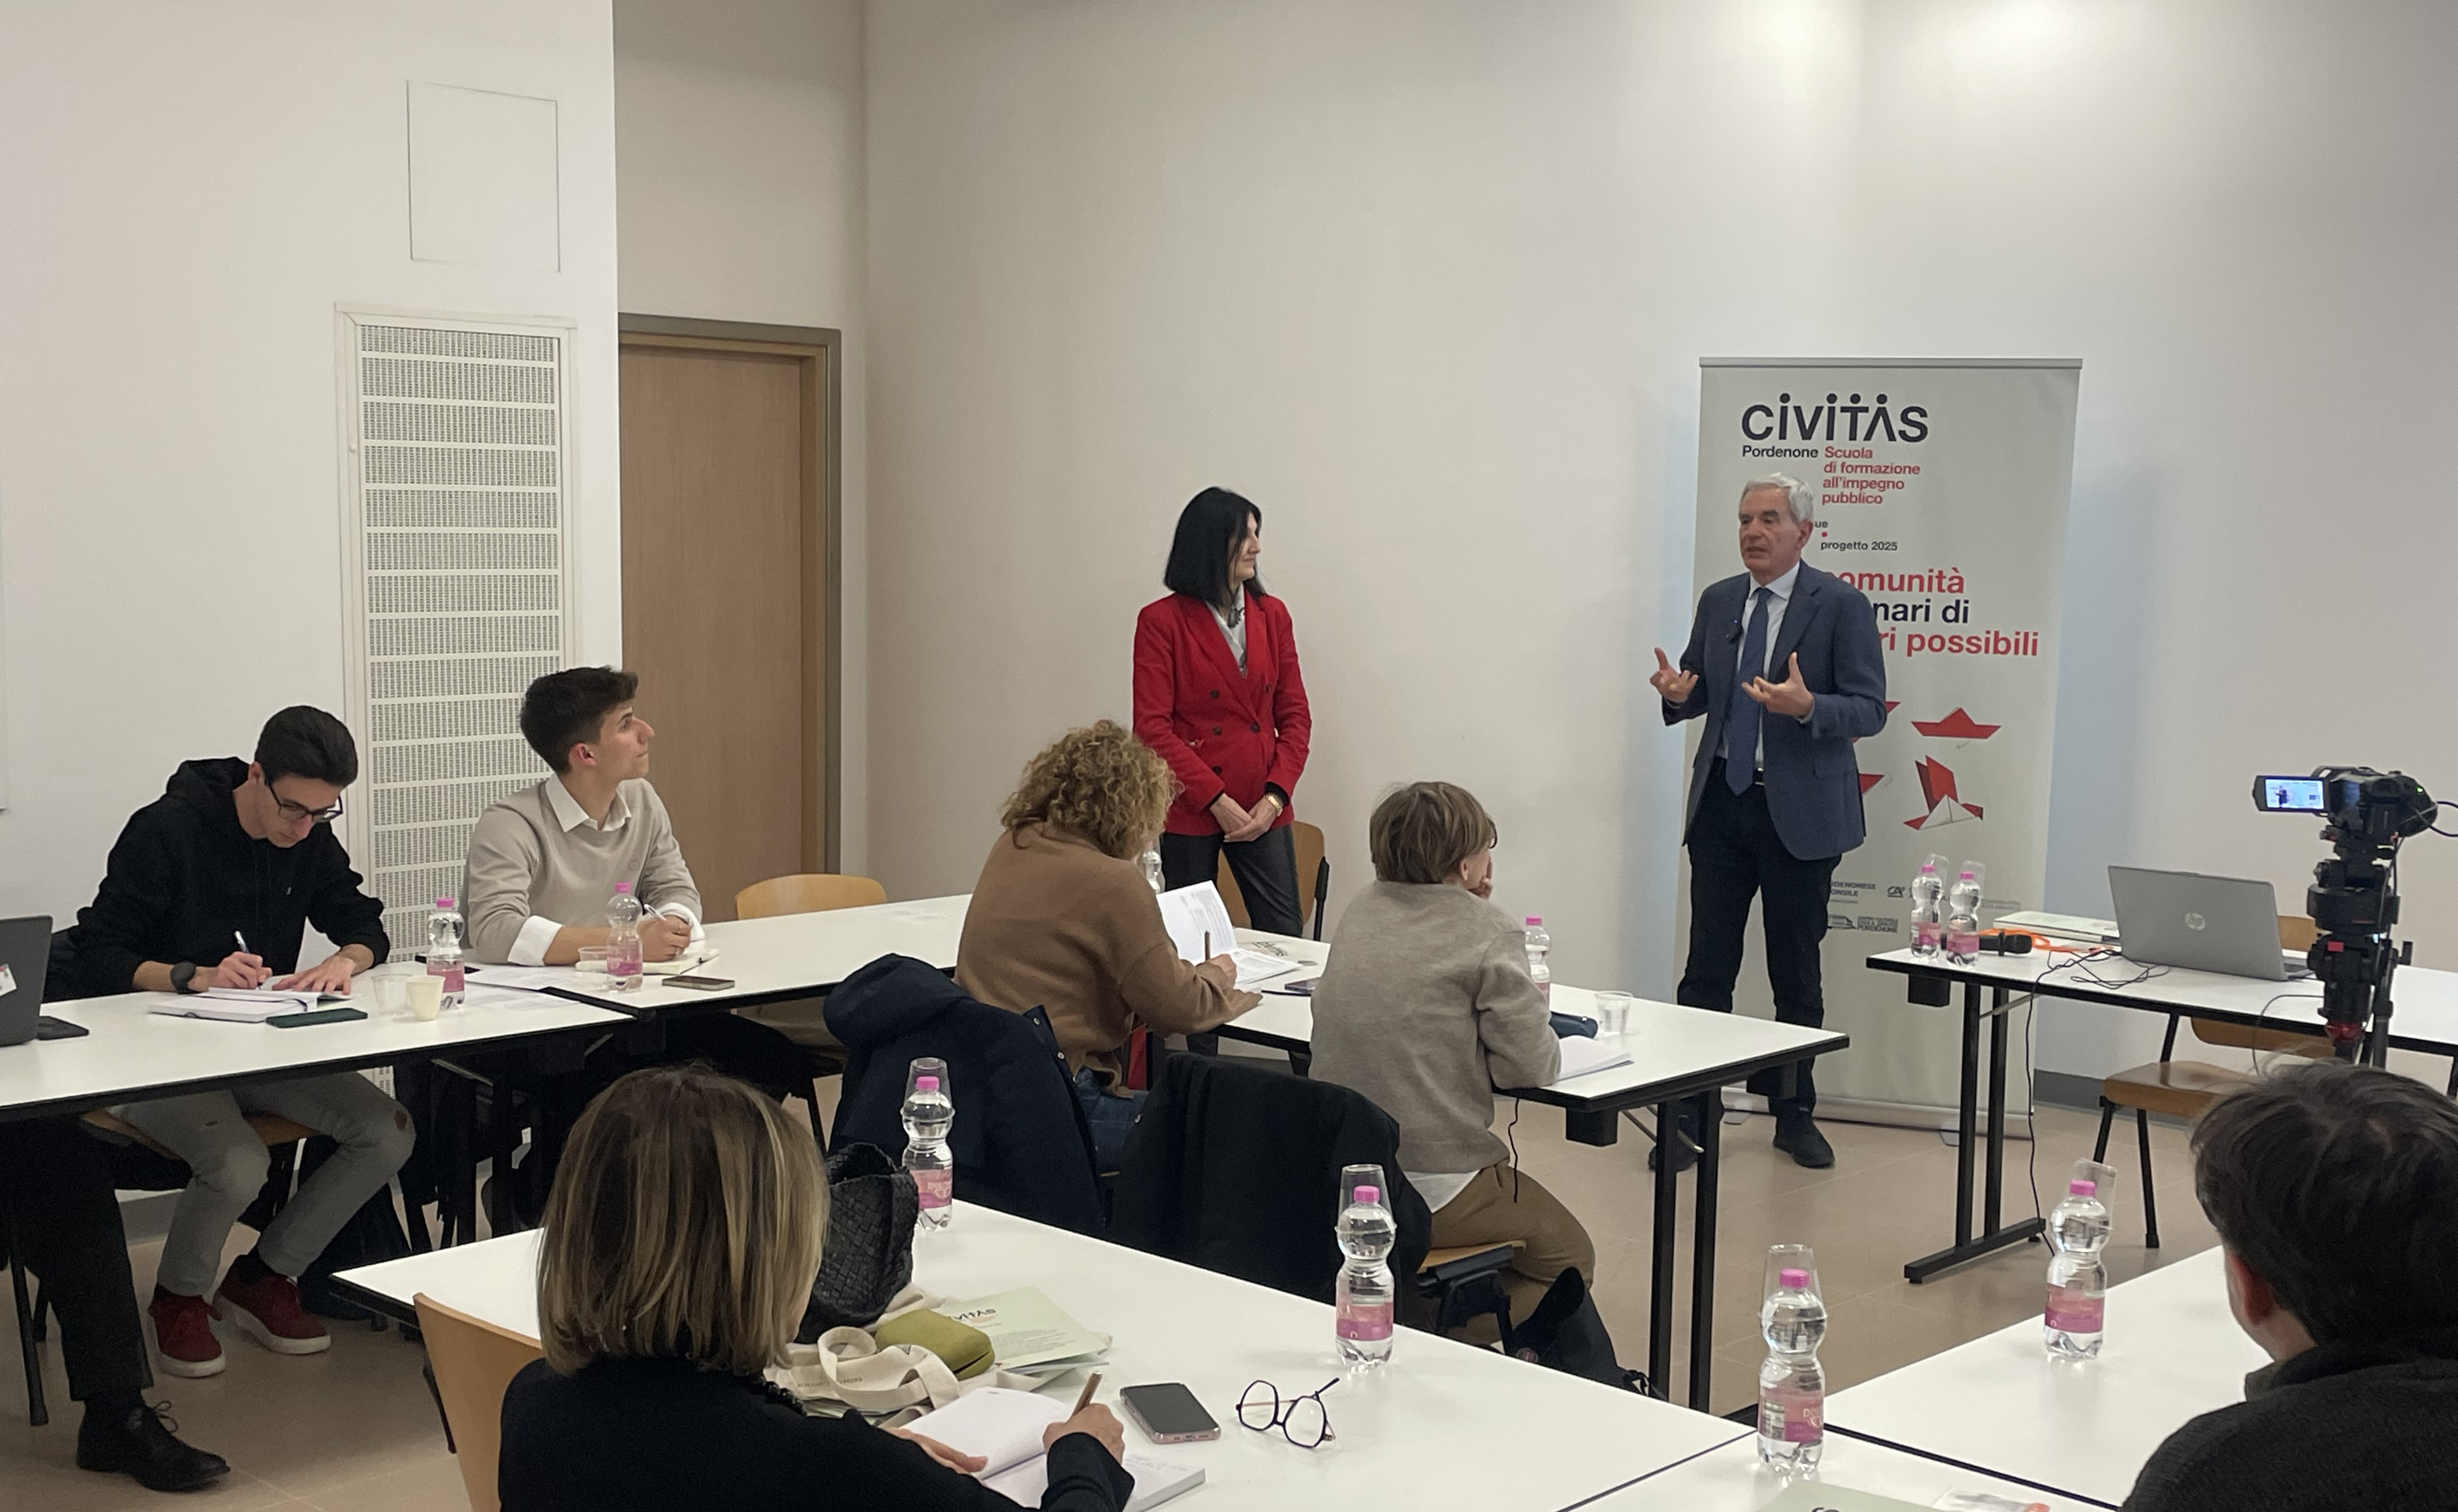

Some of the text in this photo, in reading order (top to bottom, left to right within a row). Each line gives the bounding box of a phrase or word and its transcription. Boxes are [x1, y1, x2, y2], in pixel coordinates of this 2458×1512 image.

[1742, 445, 1873, 458] Pordenone Scuola
[1823, 461, 1920, 474] di formazione
[1823, 477, 1904, 492] all'impegno
[1822, 492, 1883, 505] pubblico
[1815, 520, 1828, 528] ue
[1821, 541, 1898, 551] progetto 2025
[1825, 567, 1964, 594] omunità
[1873, 598, 1969, 623] nari di
[1879, 627, 2039, 656] ri possibili
